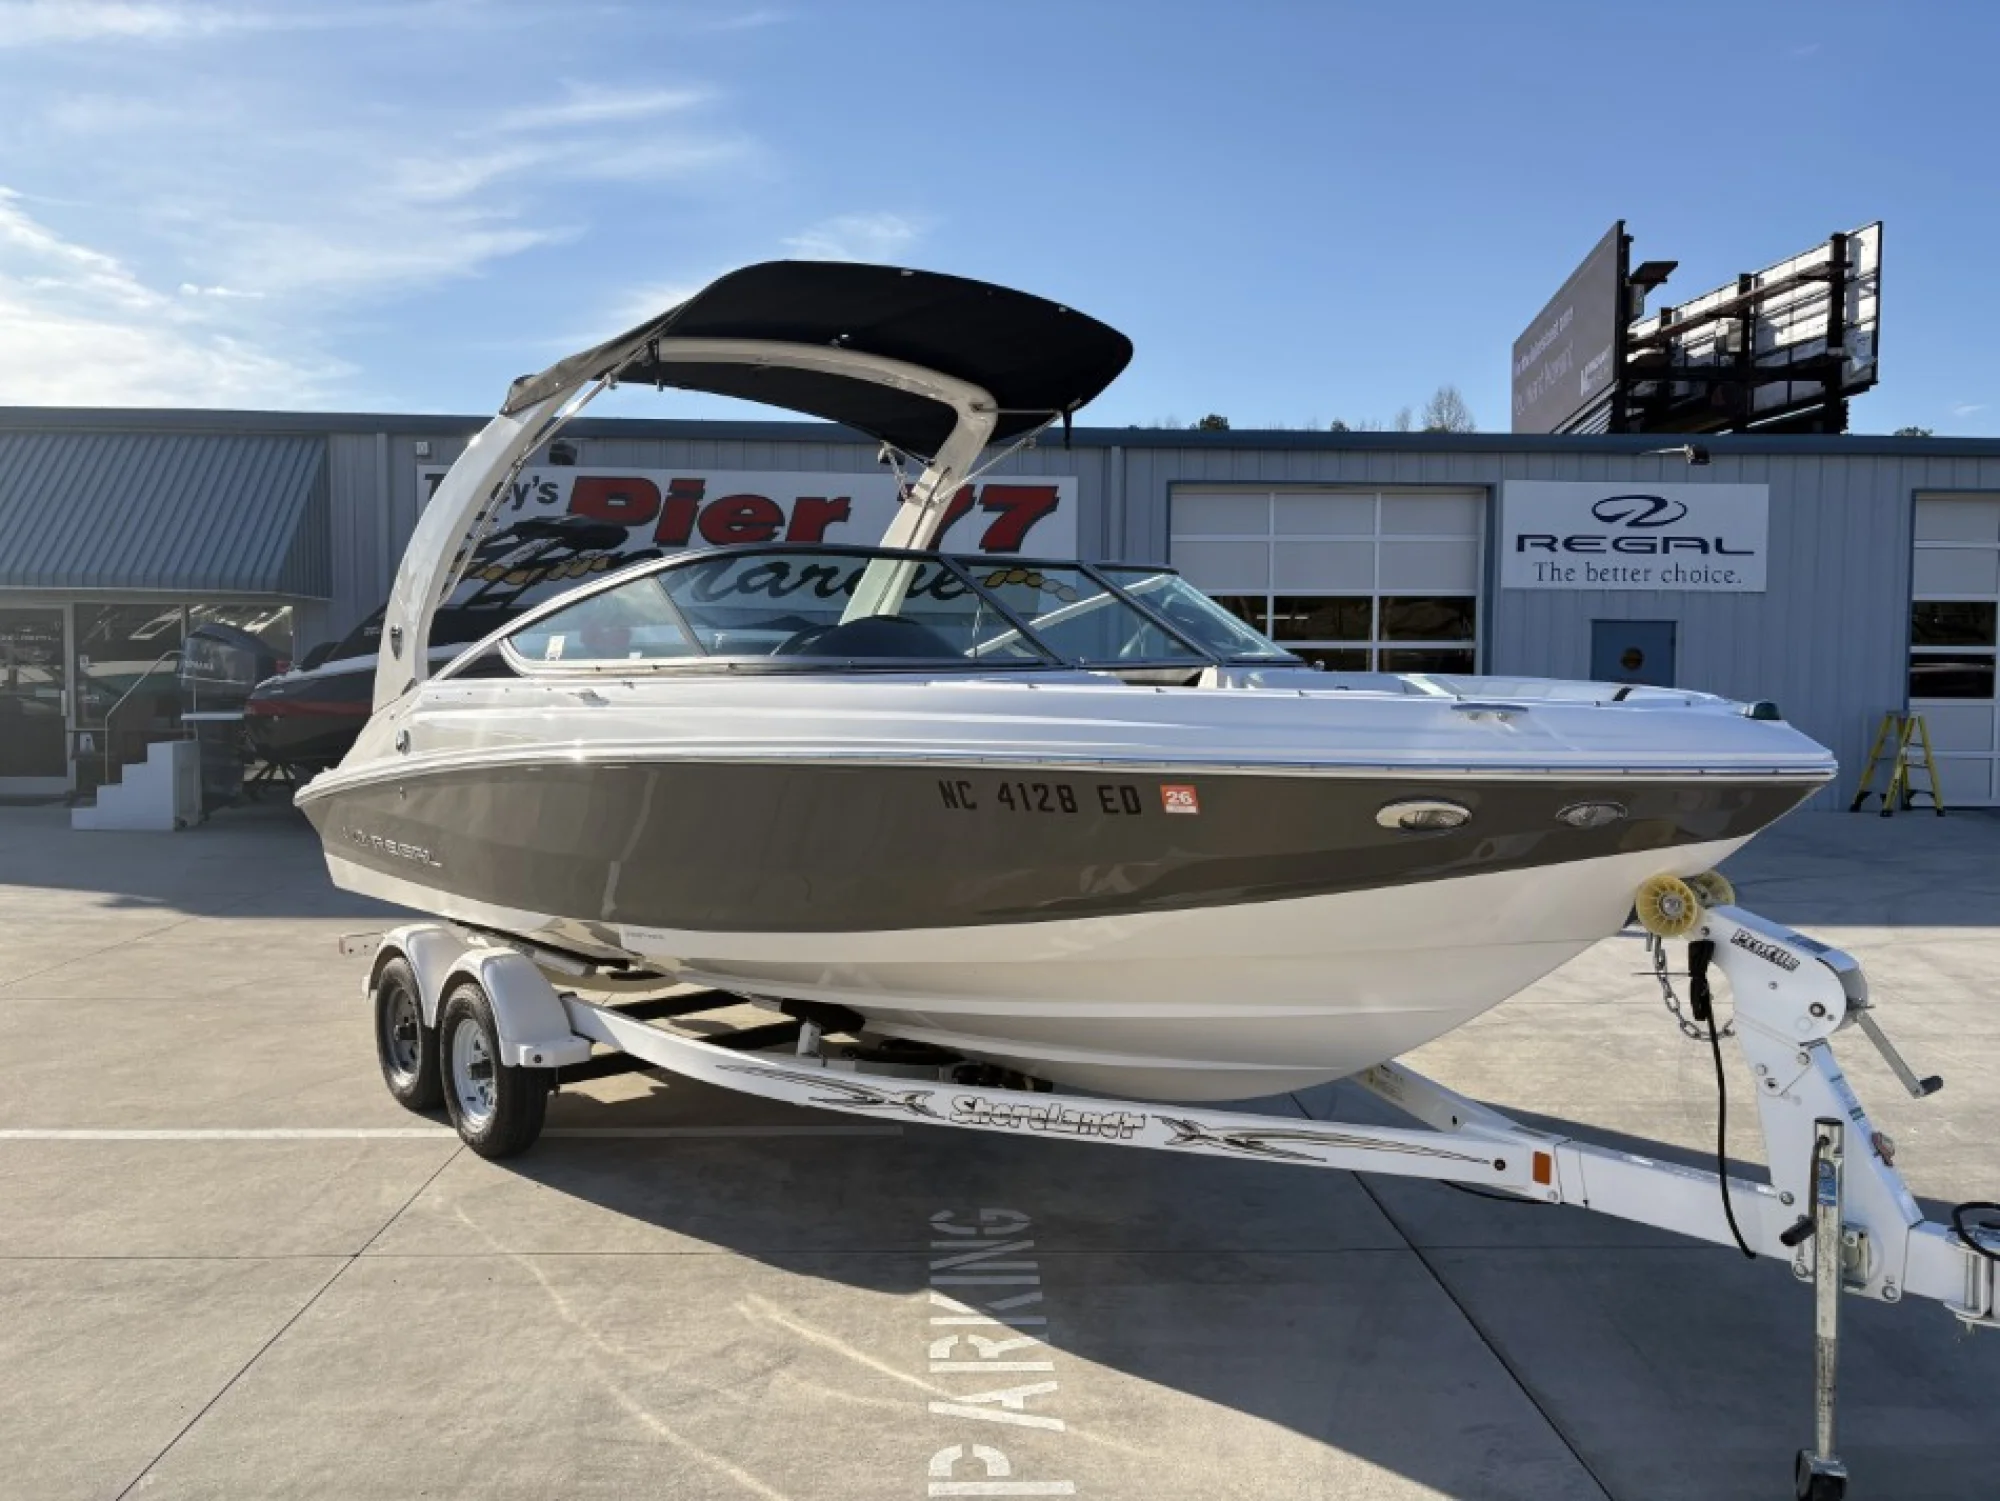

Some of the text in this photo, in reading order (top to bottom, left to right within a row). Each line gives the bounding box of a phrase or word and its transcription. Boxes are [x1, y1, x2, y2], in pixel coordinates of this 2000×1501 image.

[567, 476, 851, 547] Pier
[1516, 533, 1755, 556] REGAL
[1533, 561, 1742, 584] The better choice.
[938, 780, 977, 810] NC
[997, 782, 1078, 813] 4128
[1165, 790, 1193, 805] 26
[928, 1208, 1077, 1497] PARKING
